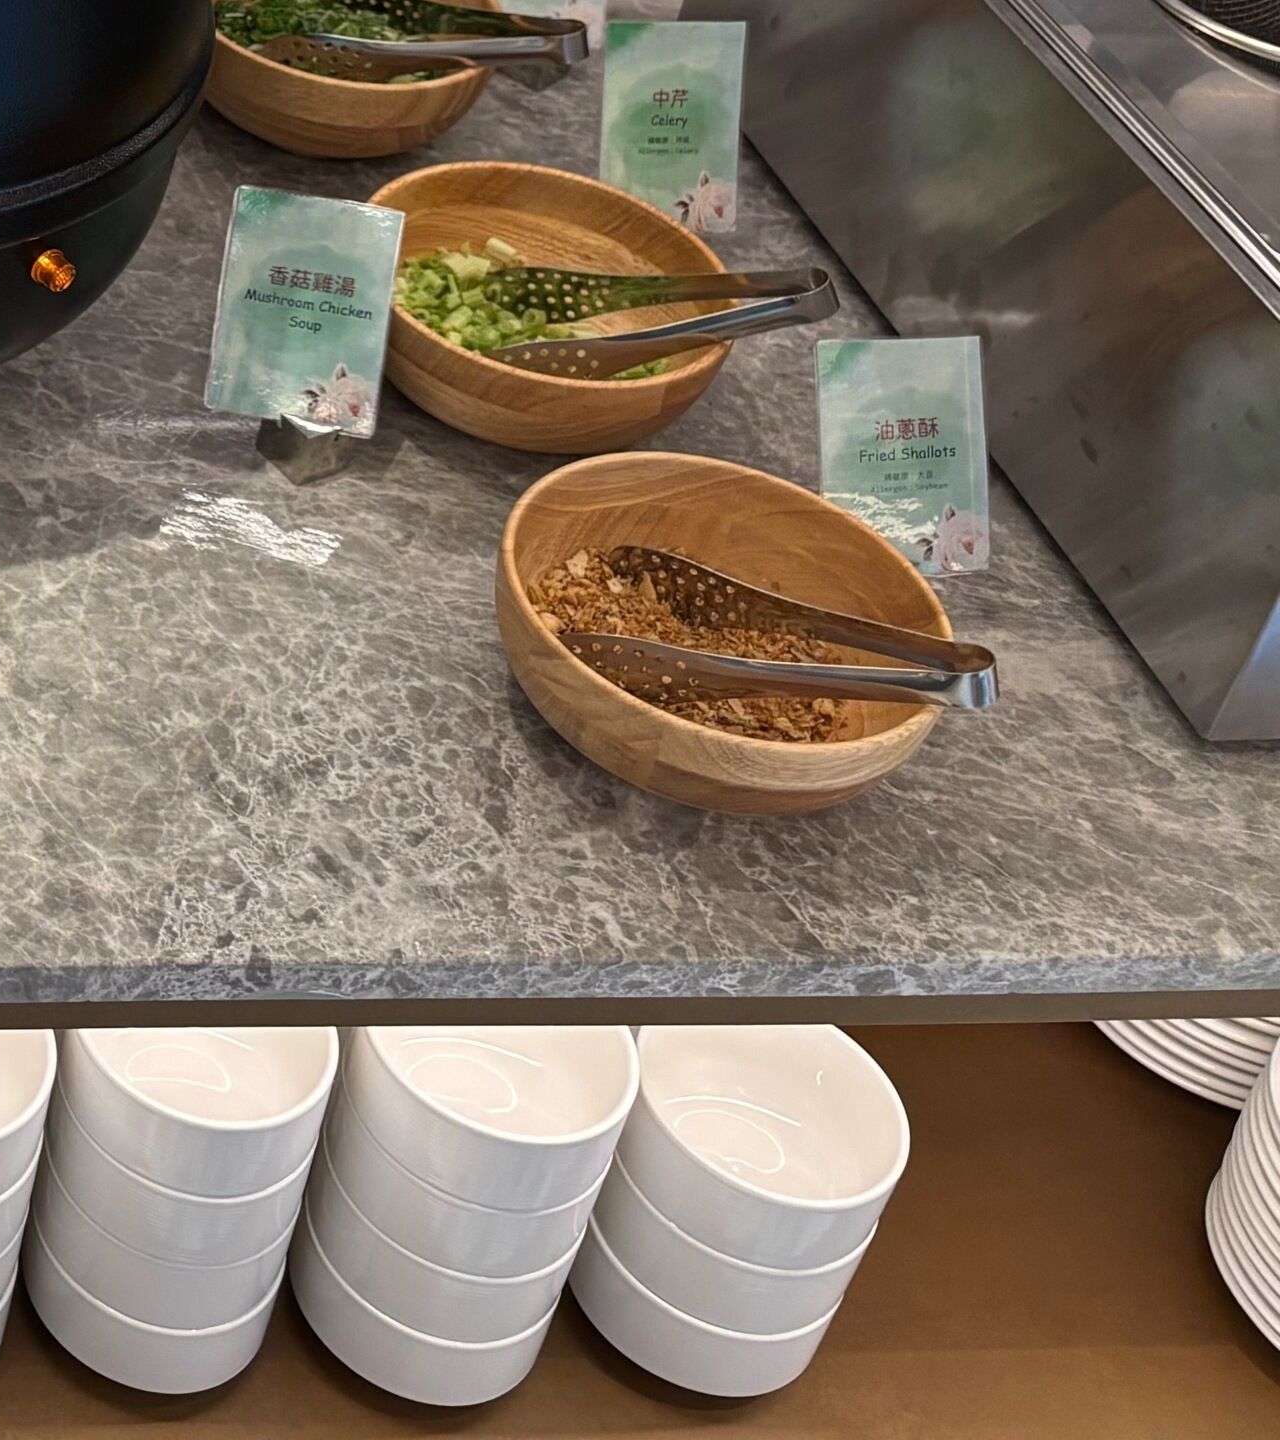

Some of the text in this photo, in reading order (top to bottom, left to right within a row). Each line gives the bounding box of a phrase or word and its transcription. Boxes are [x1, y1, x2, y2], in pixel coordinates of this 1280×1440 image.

[653, 88, 688, 108] 中芹
[651, 114, 688, 129] Celery
[268, 266, 356, 298] 香菇雞湯
[244, 288, 373, 320] Mushroom Chicken
[288, 316, 323, 334] Soup
[875, 417, 939, 441] 油蔥酥
[859, 445, 956, 463] Fried Shallots
